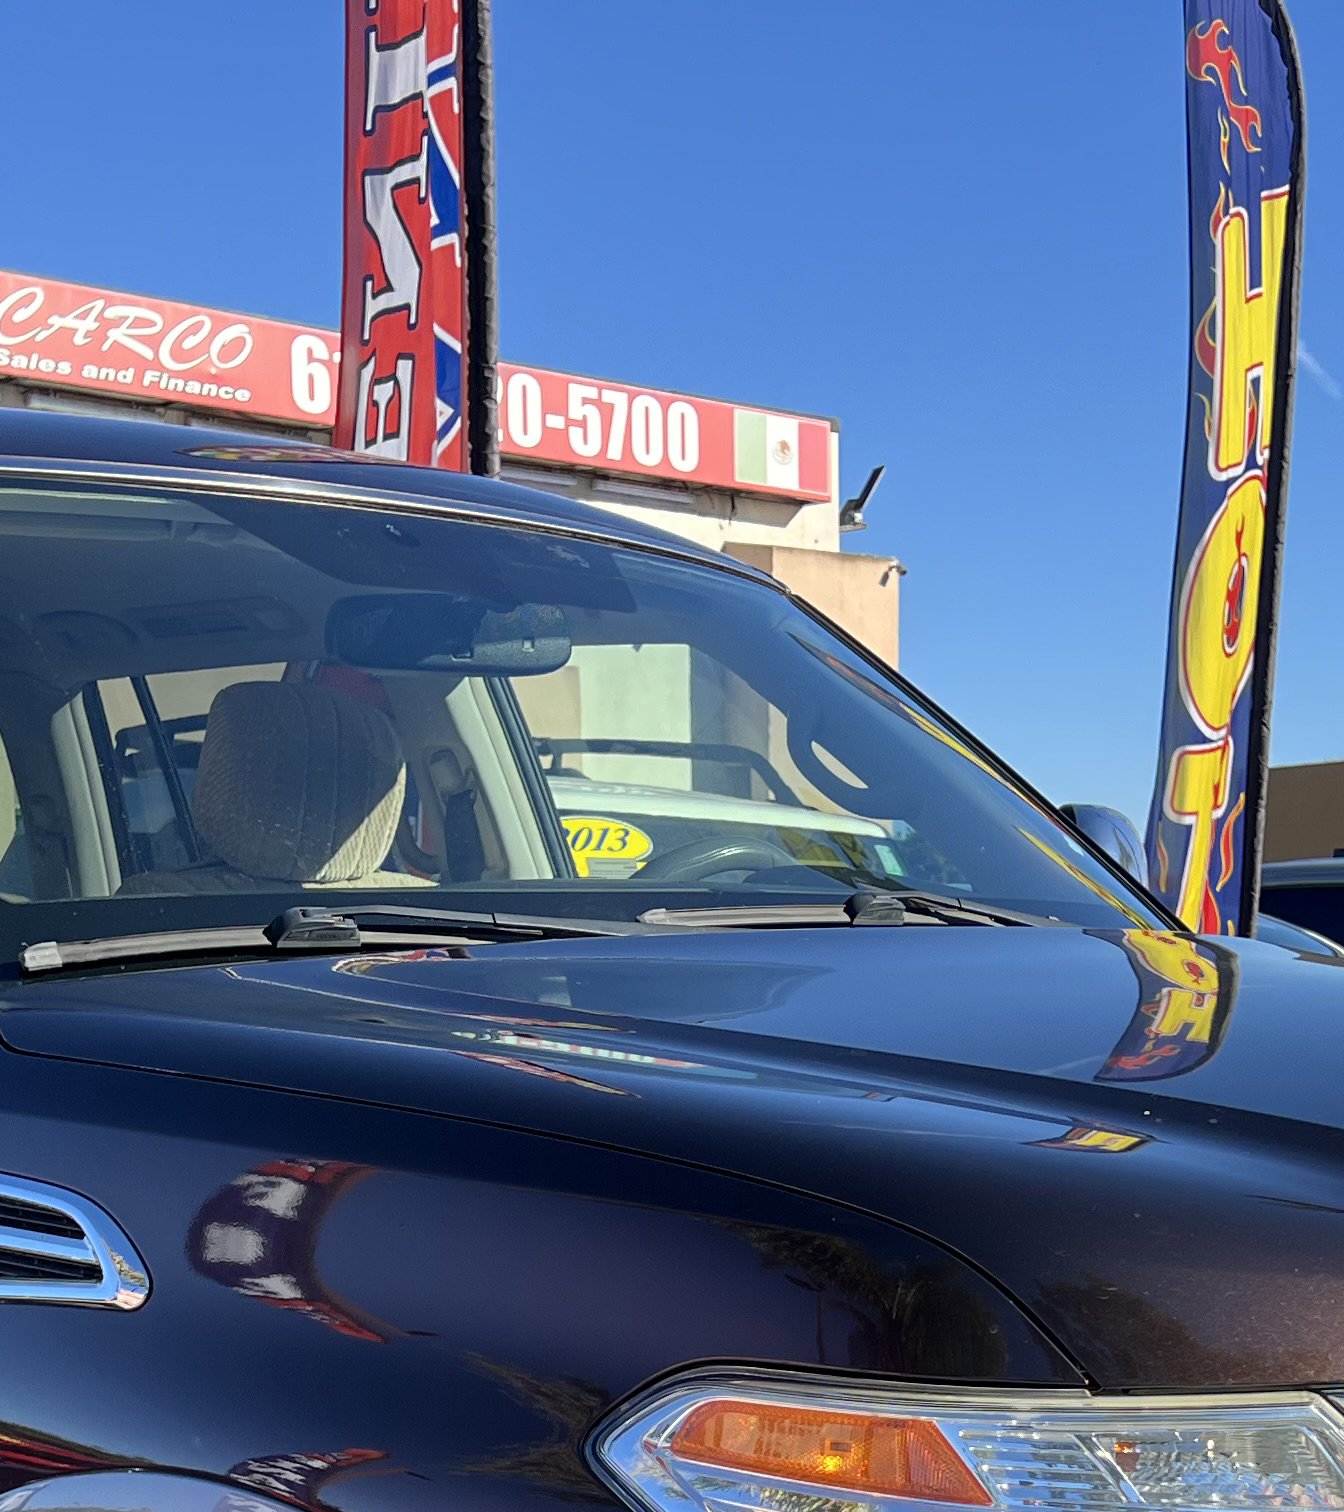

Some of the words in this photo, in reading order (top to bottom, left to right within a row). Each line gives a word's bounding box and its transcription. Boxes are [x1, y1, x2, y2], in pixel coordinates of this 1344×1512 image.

[81, 362, 136, 385] and
[142, 369, 252, 402] Finance
[557, 826, 631, 853] 013
